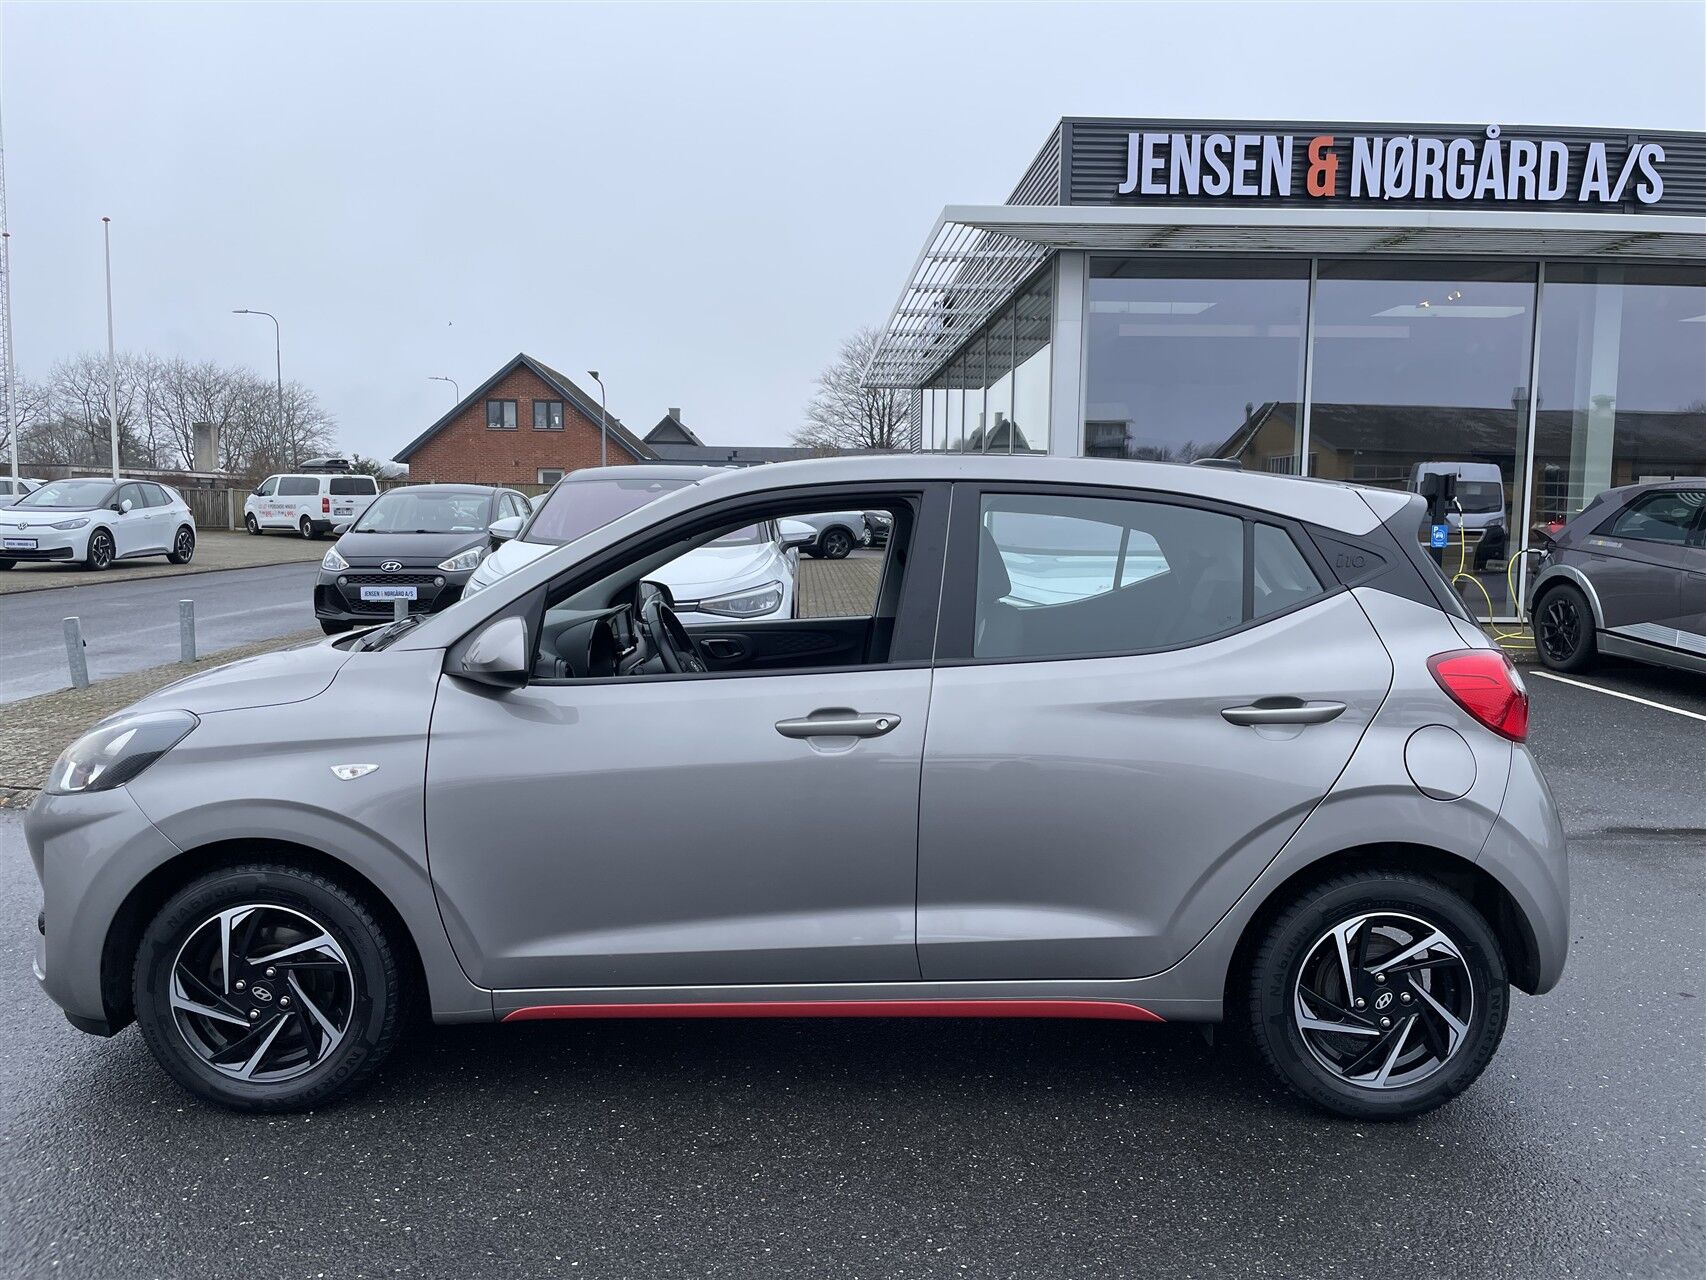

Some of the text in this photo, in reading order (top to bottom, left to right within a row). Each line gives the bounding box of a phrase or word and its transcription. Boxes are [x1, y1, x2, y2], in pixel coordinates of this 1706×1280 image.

[1118, 124, 1666, 205] JENSEN & NØRGÅRD A/S
